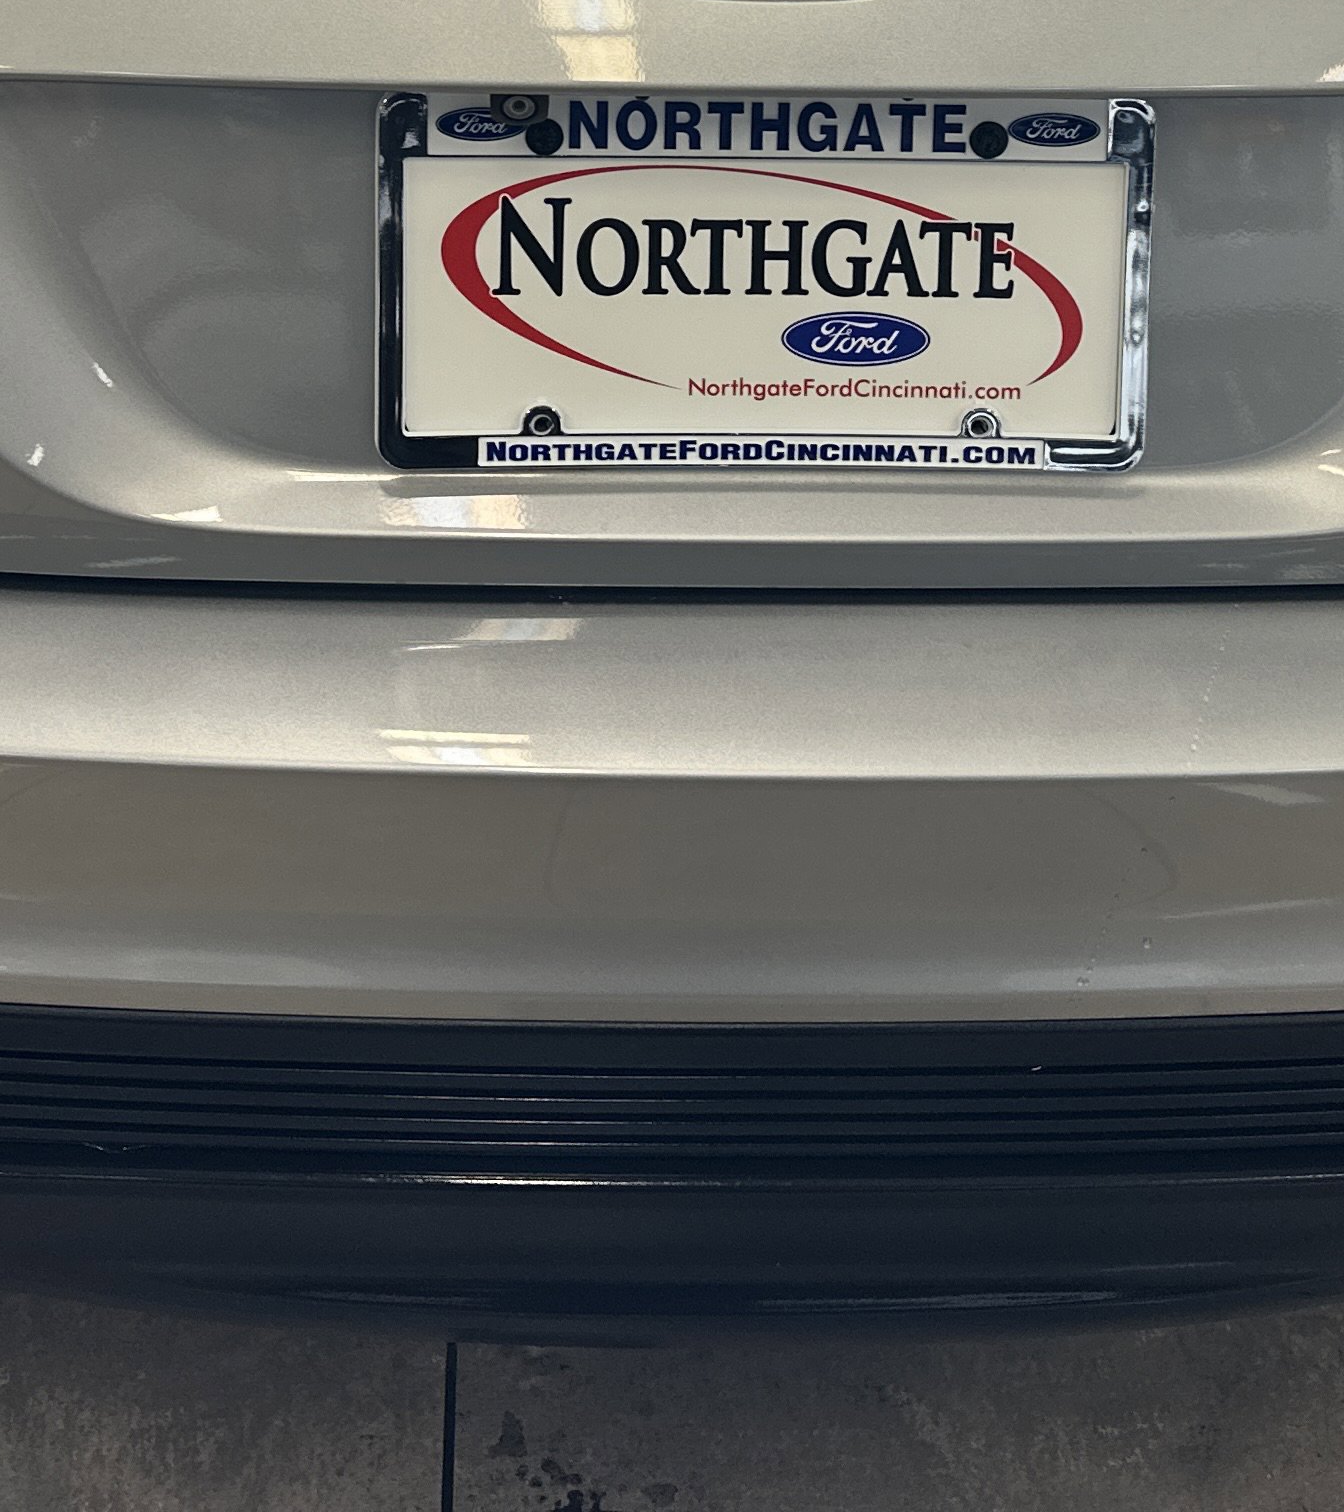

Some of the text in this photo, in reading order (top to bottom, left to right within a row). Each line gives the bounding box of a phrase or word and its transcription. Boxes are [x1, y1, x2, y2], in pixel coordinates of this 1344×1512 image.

[568, 100, 968, 153] NORTHGATE
[1025, 119, 1081, 141] Ford
[492, 195, 1015, 299] NORTHGATE
[810, 319, 901, 355] Ford
[688, 376, 1021, 401] NorthgateFordCincinnati.com
